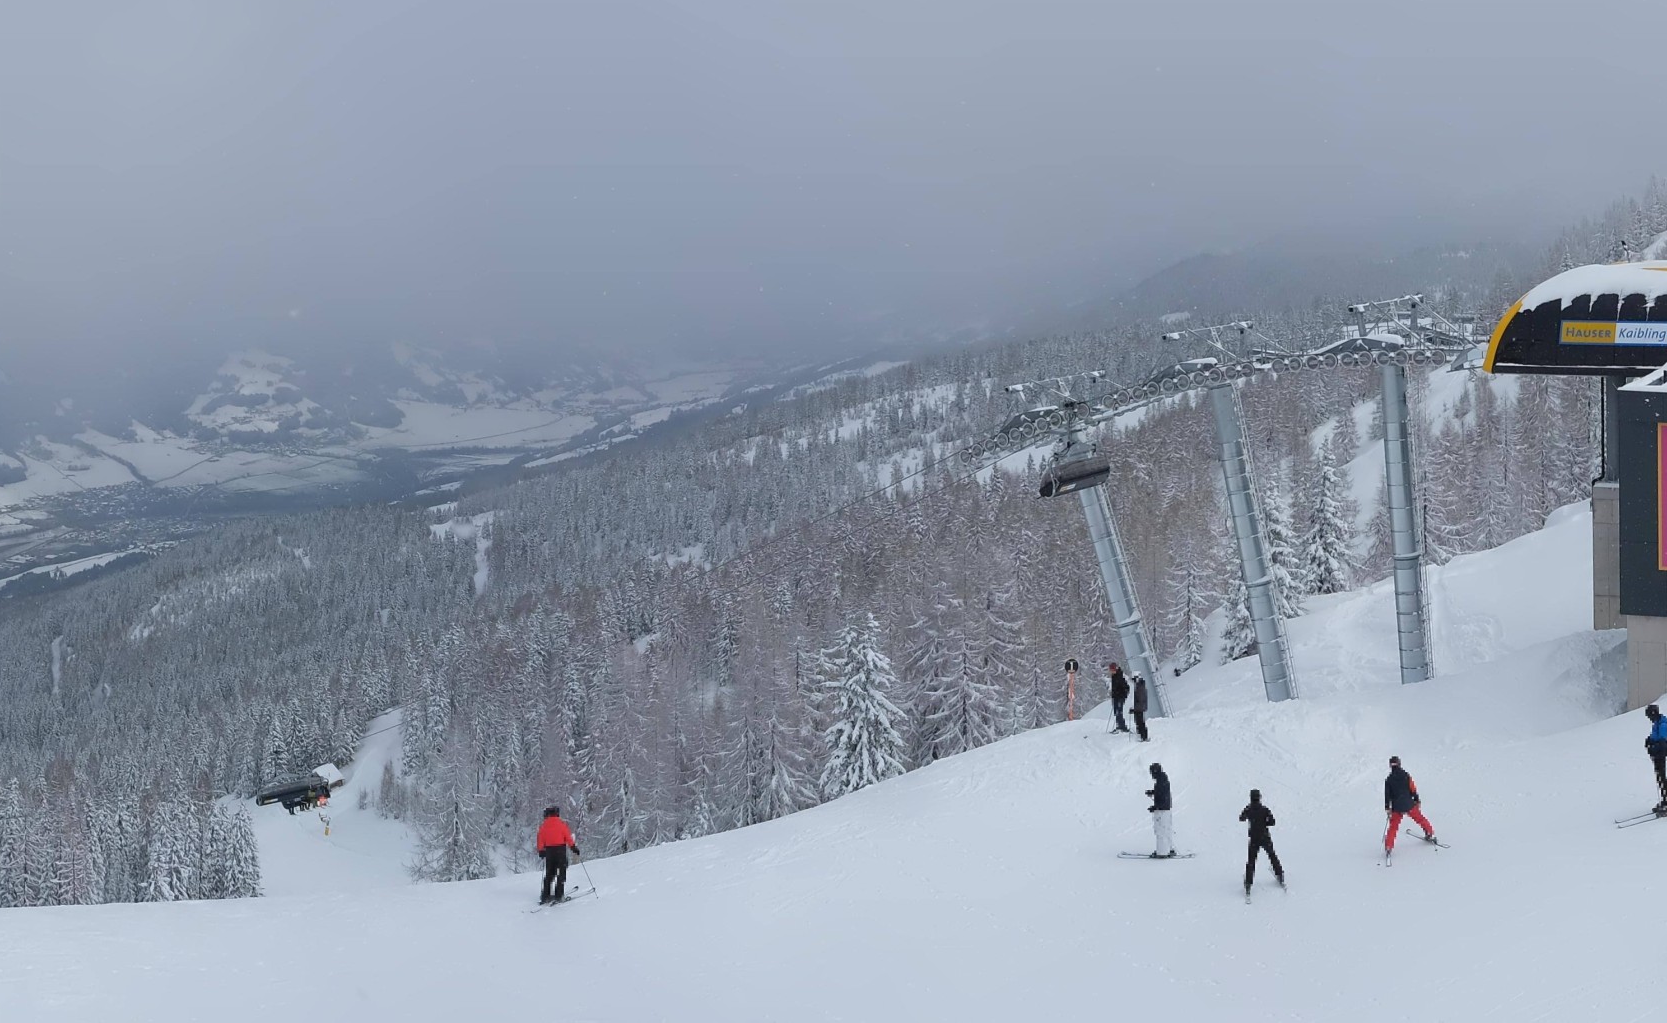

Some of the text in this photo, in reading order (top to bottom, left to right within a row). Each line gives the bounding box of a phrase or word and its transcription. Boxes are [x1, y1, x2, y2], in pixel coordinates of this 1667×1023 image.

[1566, 327, 1666, 342] HAUSER Kaibling
[1068, 661, 1076, 672] 1
